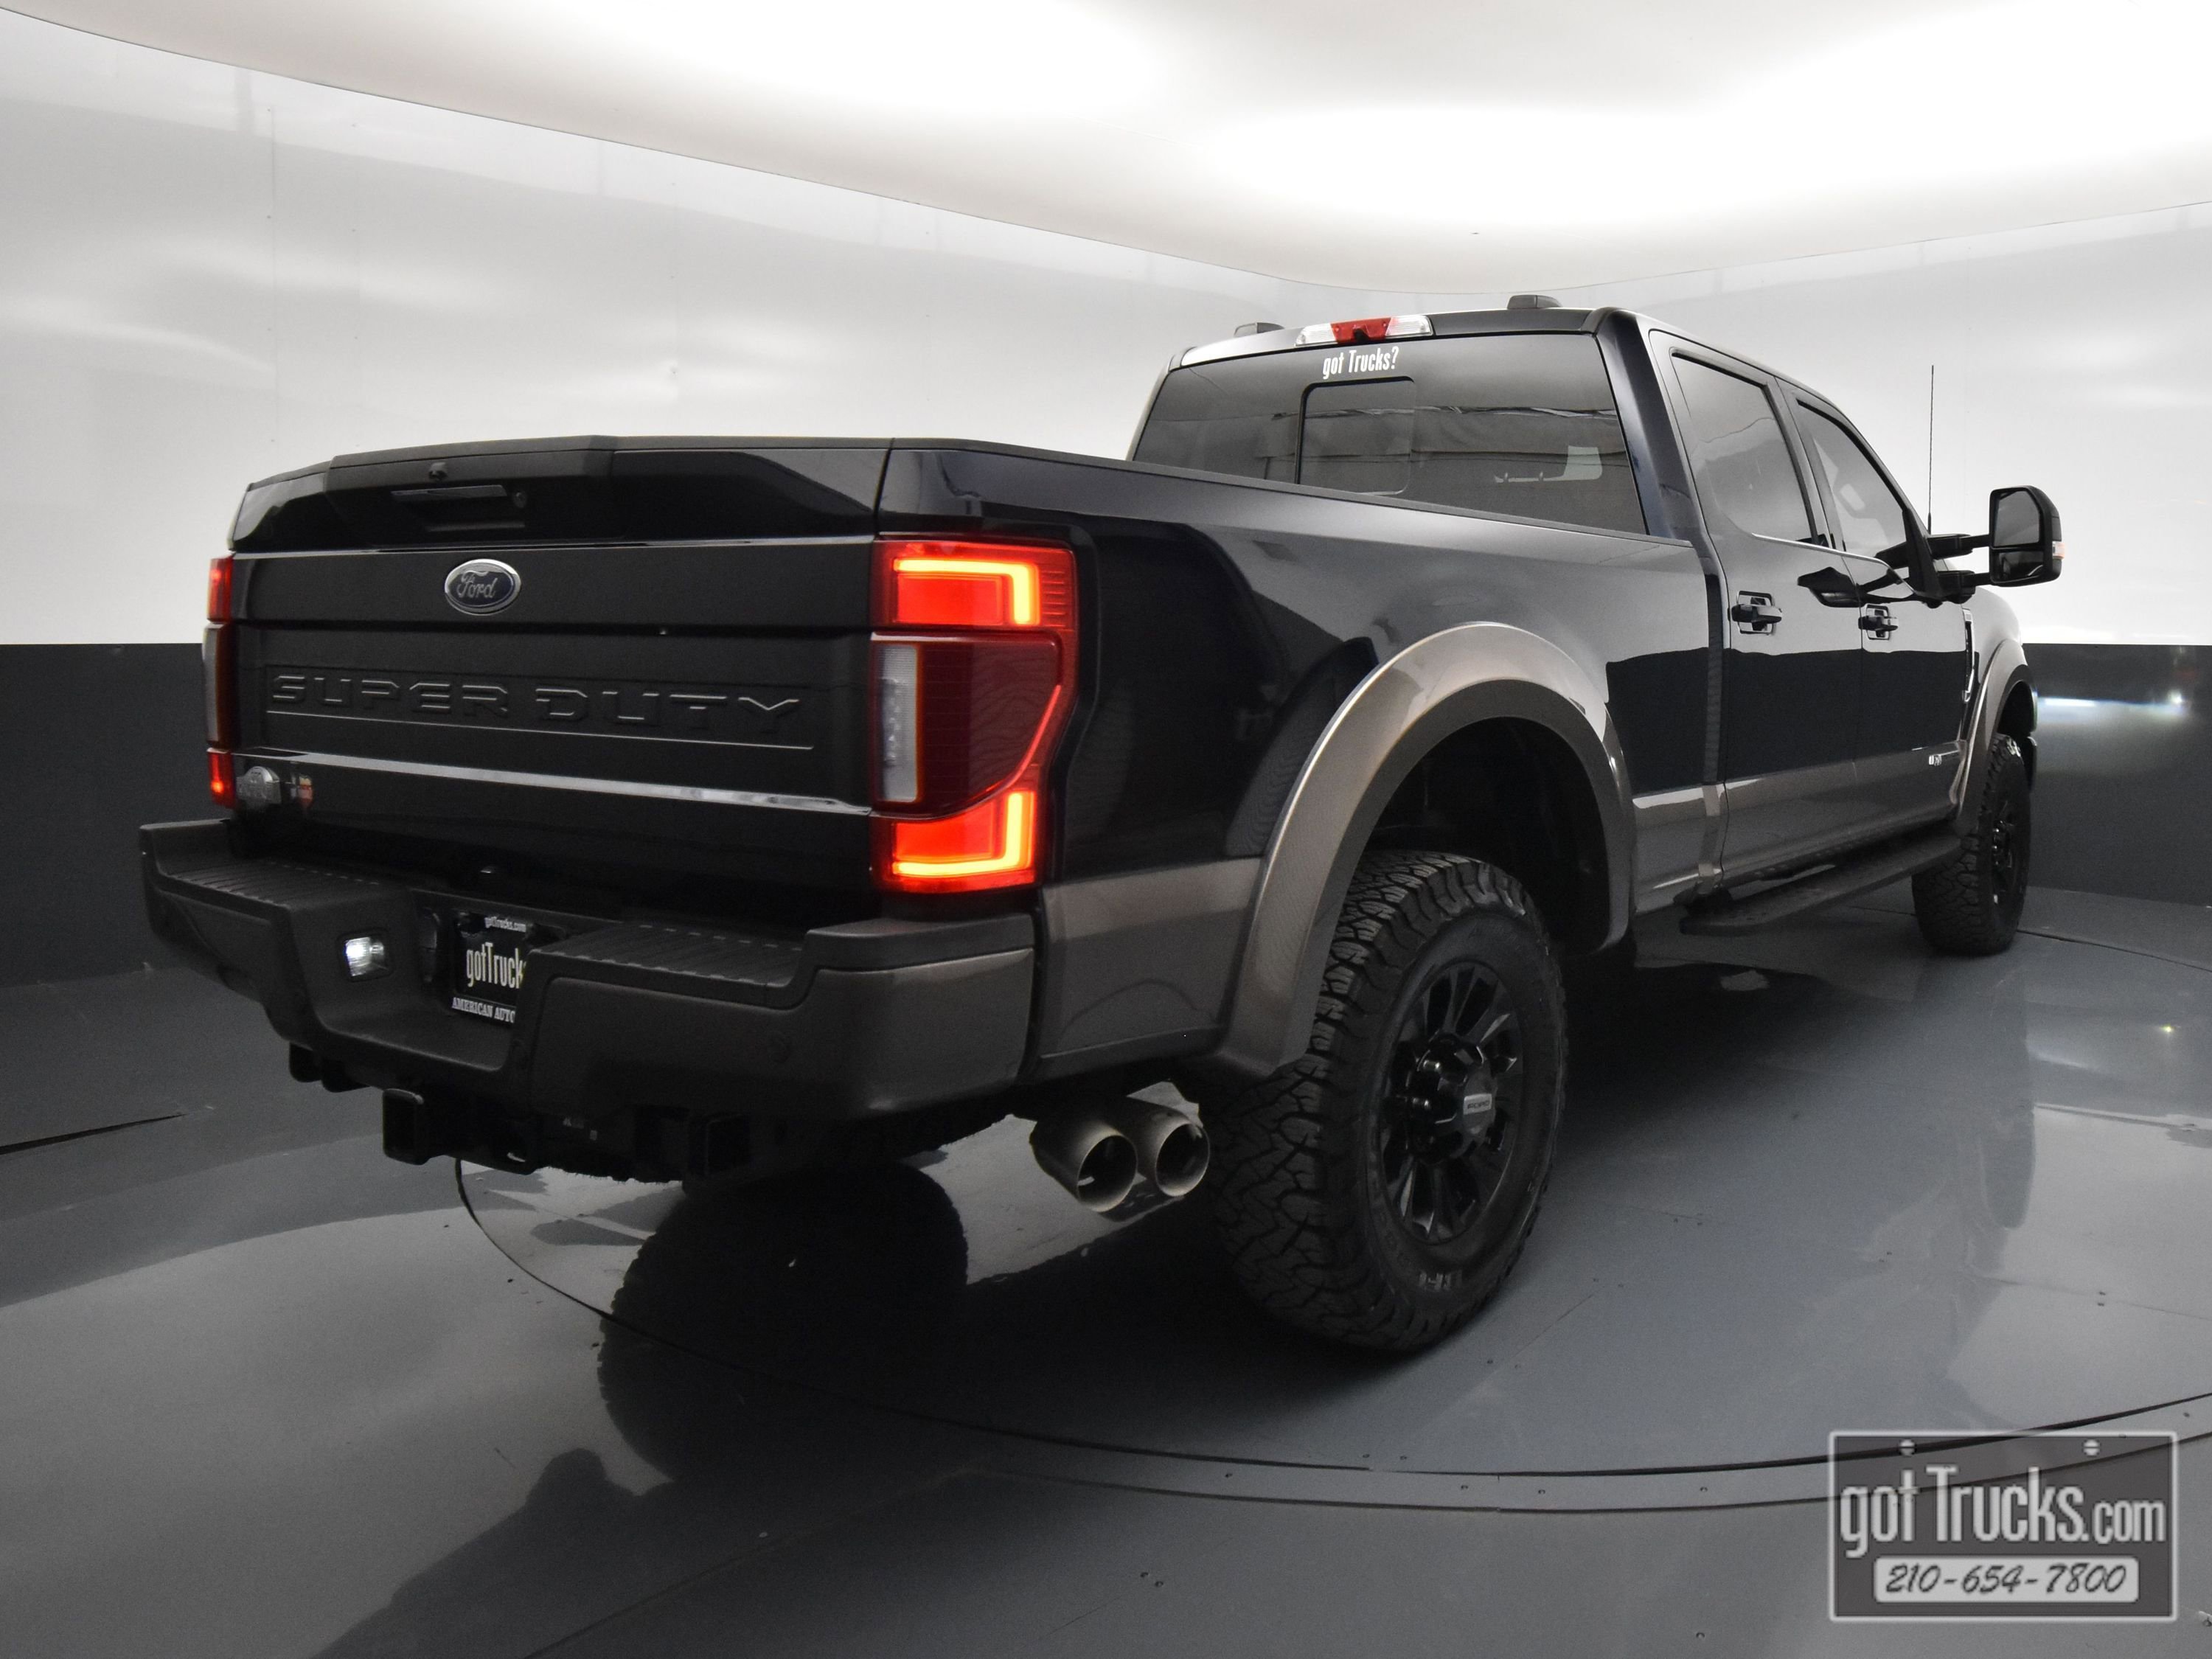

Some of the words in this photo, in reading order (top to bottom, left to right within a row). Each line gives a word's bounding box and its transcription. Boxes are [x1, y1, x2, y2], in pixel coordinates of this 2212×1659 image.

[1322, 352, 1344, 380] got
[1348, 346, 1399, 373] Trucks?
[456, 570, 498, 598] Ford
[272, 675, 508, 718] SUPER
[535, 686, 801, 734] DUTY
[466, 942, 527, 990] gotTruck
[451, 997, 493, 1018] AMERICAN
